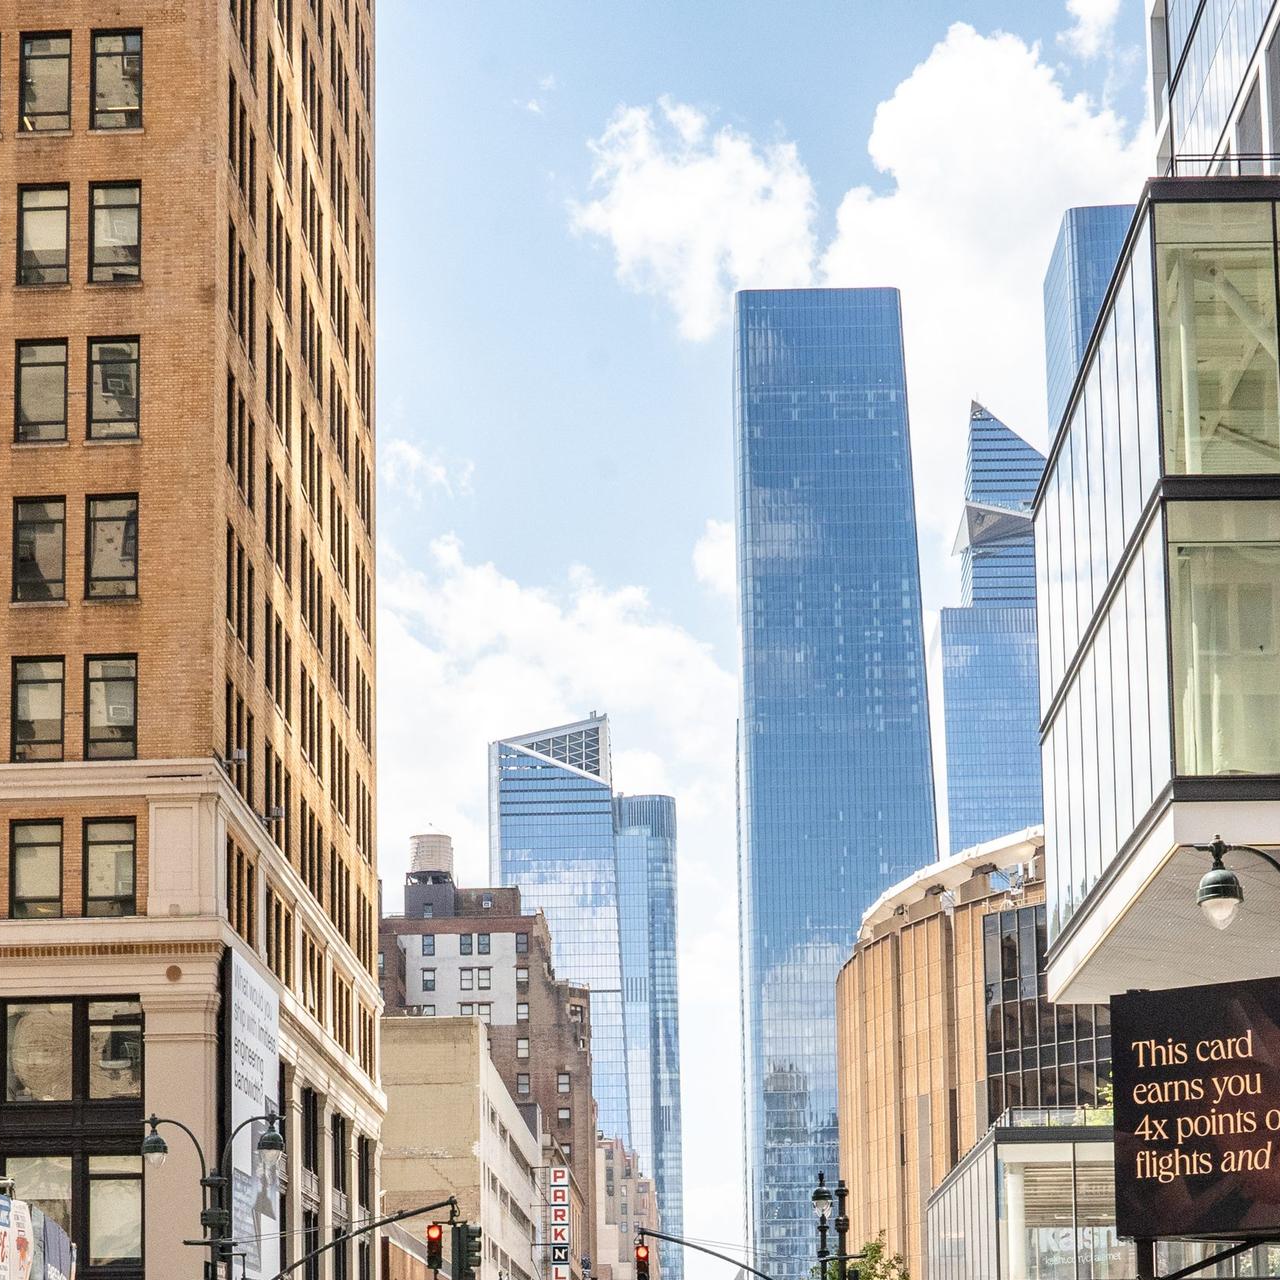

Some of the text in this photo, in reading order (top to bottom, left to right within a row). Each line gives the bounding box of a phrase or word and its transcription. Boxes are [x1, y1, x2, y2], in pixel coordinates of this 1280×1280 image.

[1131, 1030, 1253, 1068] This card
[1133, 1073, 1262, 1105] earns you
[1134, 1114, 1168, 1141] 4x
[1176, 1108, 1257, 1144] points
[1136, 1148, 1212, 1184] flights
[1220, 1141, 1273, 1172] and
[553, 1169, 566, 1241] PARK
